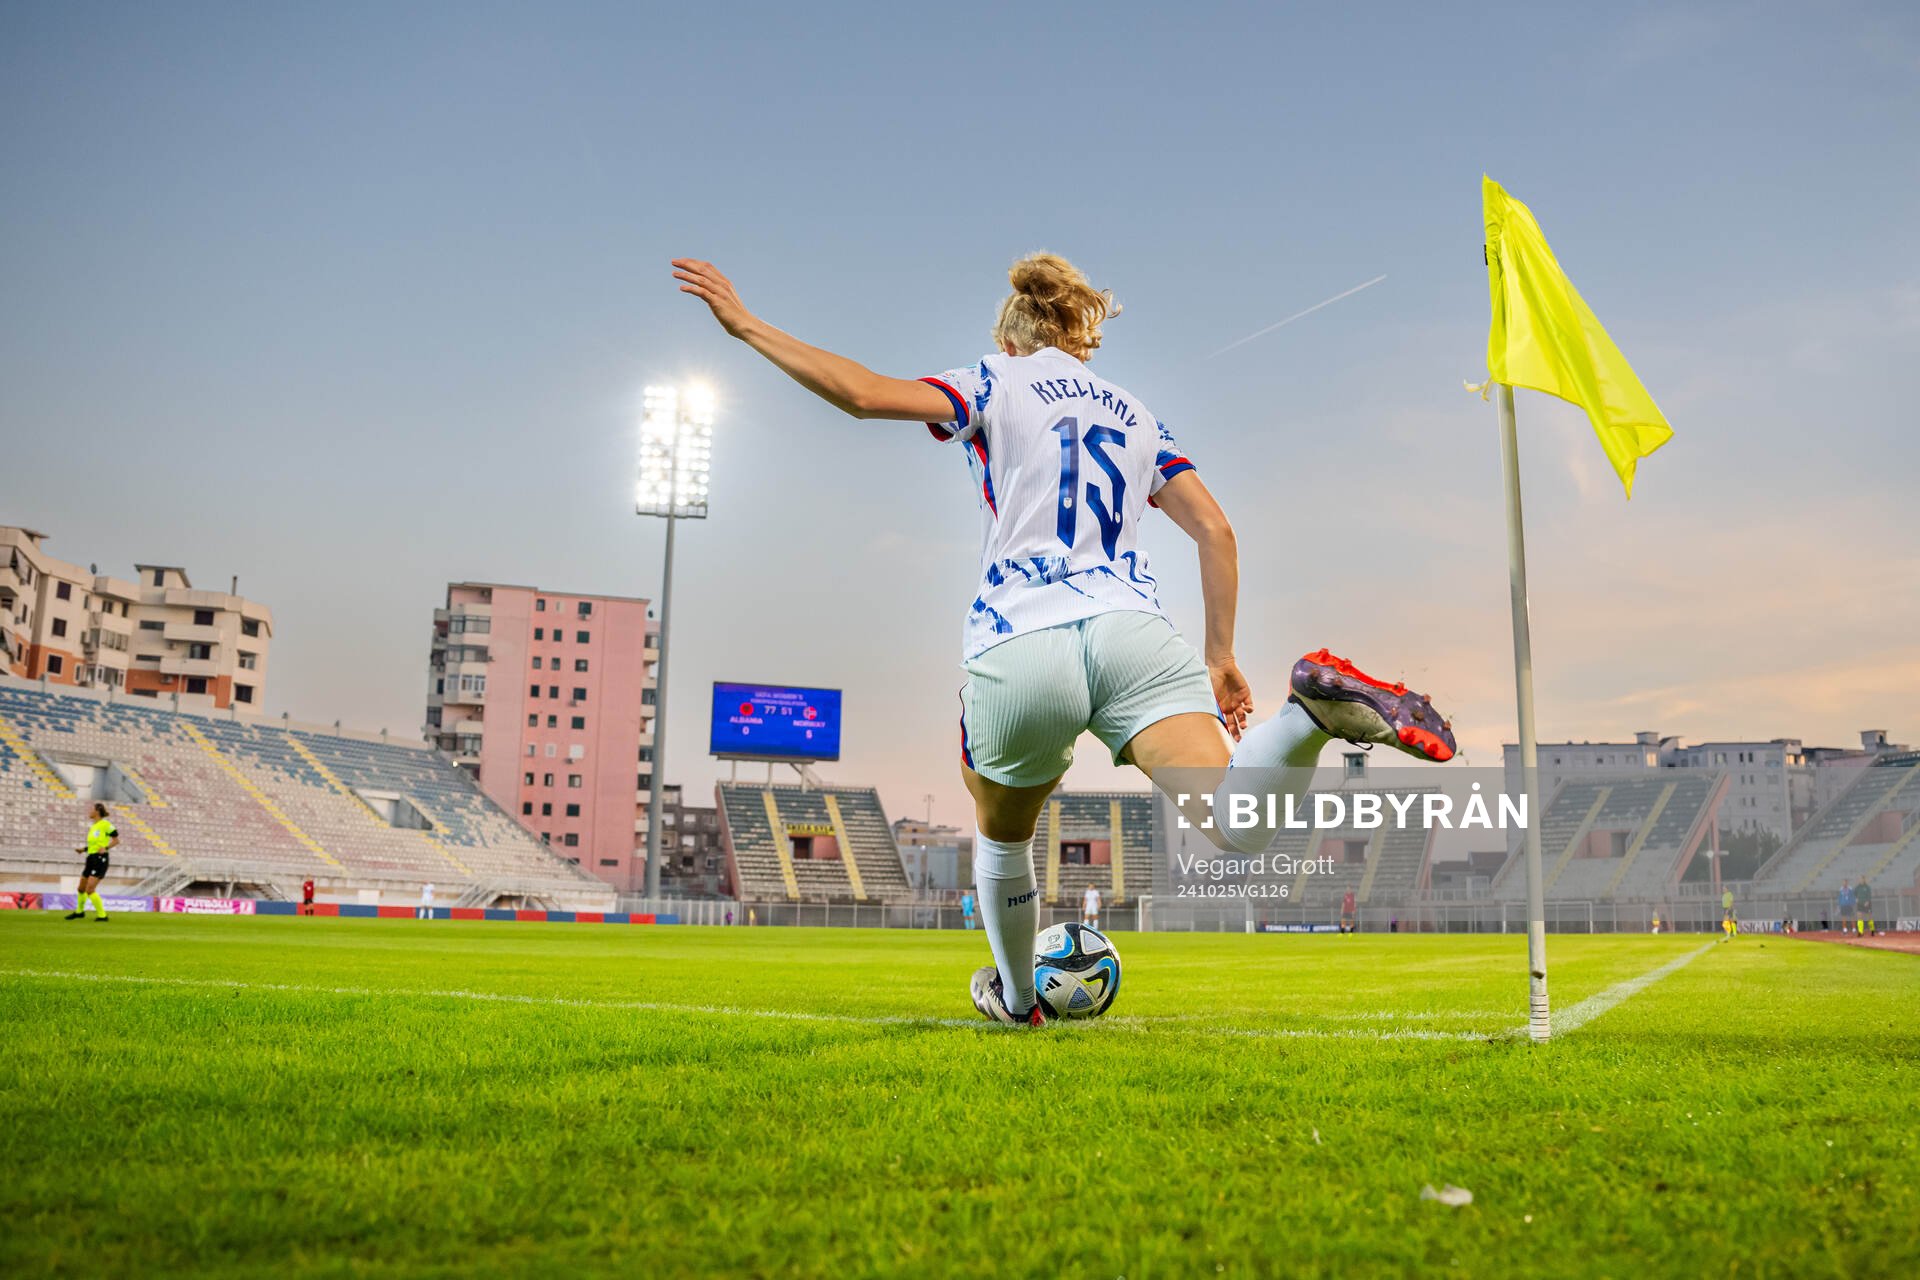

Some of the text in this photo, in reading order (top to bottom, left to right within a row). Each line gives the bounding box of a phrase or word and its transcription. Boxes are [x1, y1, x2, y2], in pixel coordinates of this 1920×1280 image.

[1050, 416, 1127, 562] 15
[730, 716, 763, 725] ALBANIA
[793, 720, 826, 728] NORWAY
